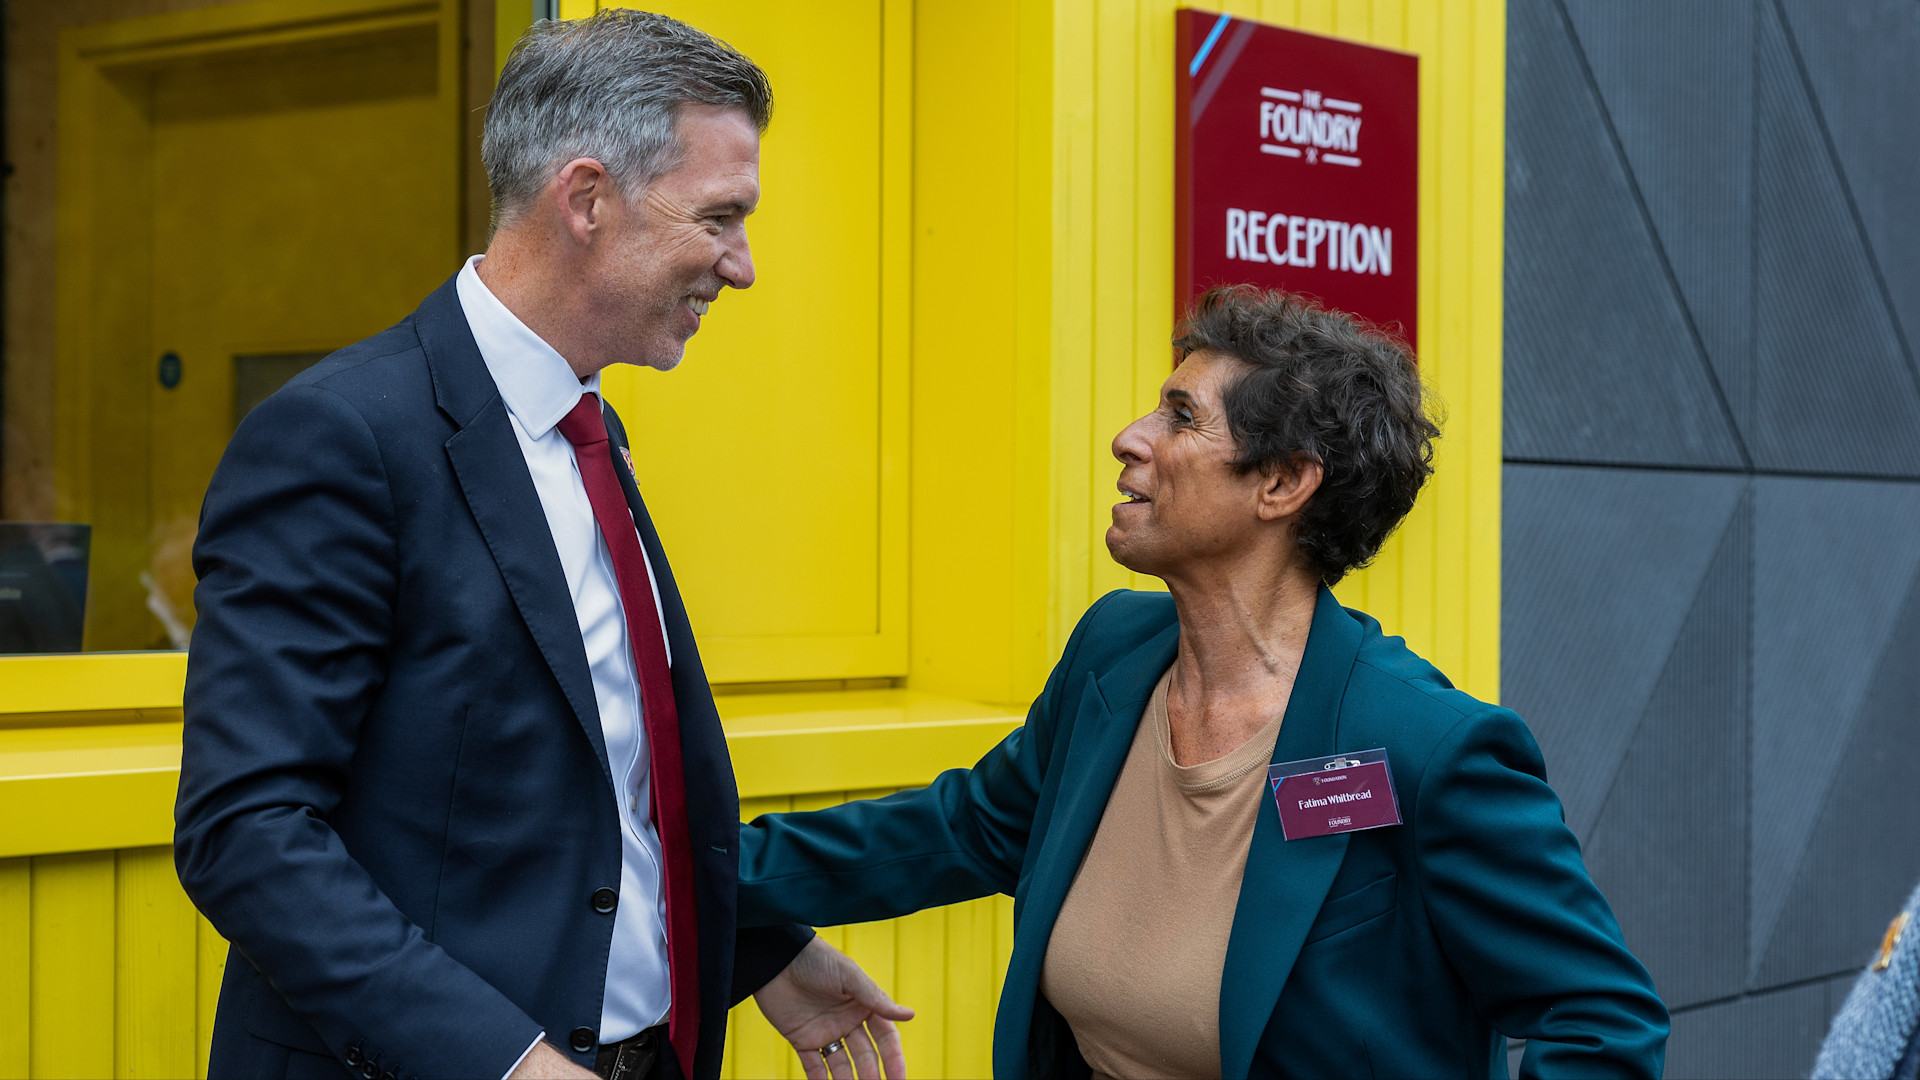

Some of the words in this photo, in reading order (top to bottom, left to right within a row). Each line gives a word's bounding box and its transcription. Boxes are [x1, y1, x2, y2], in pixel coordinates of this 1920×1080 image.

[1303, 89, 1321, 109] THE
[1260, 101, 1361, 152] FOUNDRY
[1226, 207, 1392, 277] RECEPTION
[1298, 796, 1328, 810] Fatima
[1328, 790, 1371, 803] Whitbread
[1328, 818, 1351, 826] FOUNDRY
